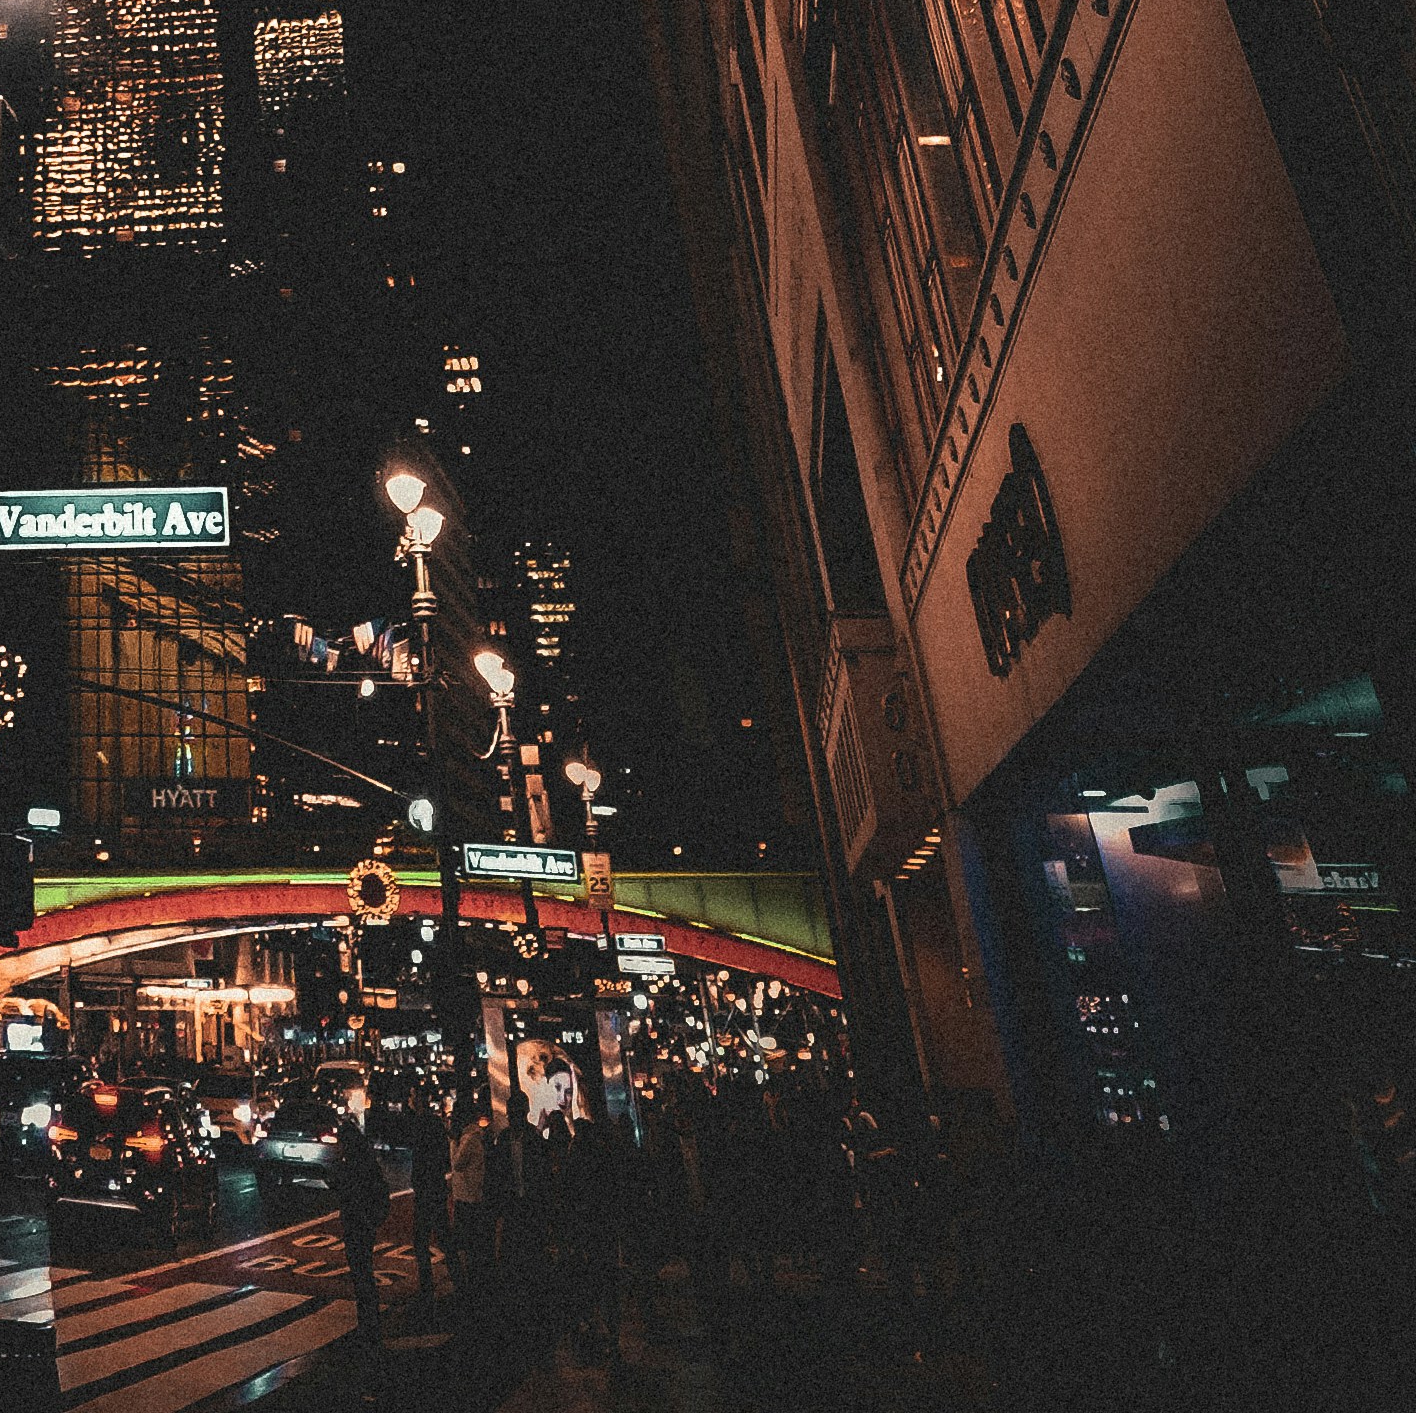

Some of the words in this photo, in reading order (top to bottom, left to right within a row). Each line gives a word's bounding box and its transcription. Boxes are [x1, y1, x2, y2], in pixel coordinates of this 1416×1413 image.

[162, 502, 223, 536] Ave
[151, 787, 218, 809] HYATT
[589, 876, 610, 893] 25
